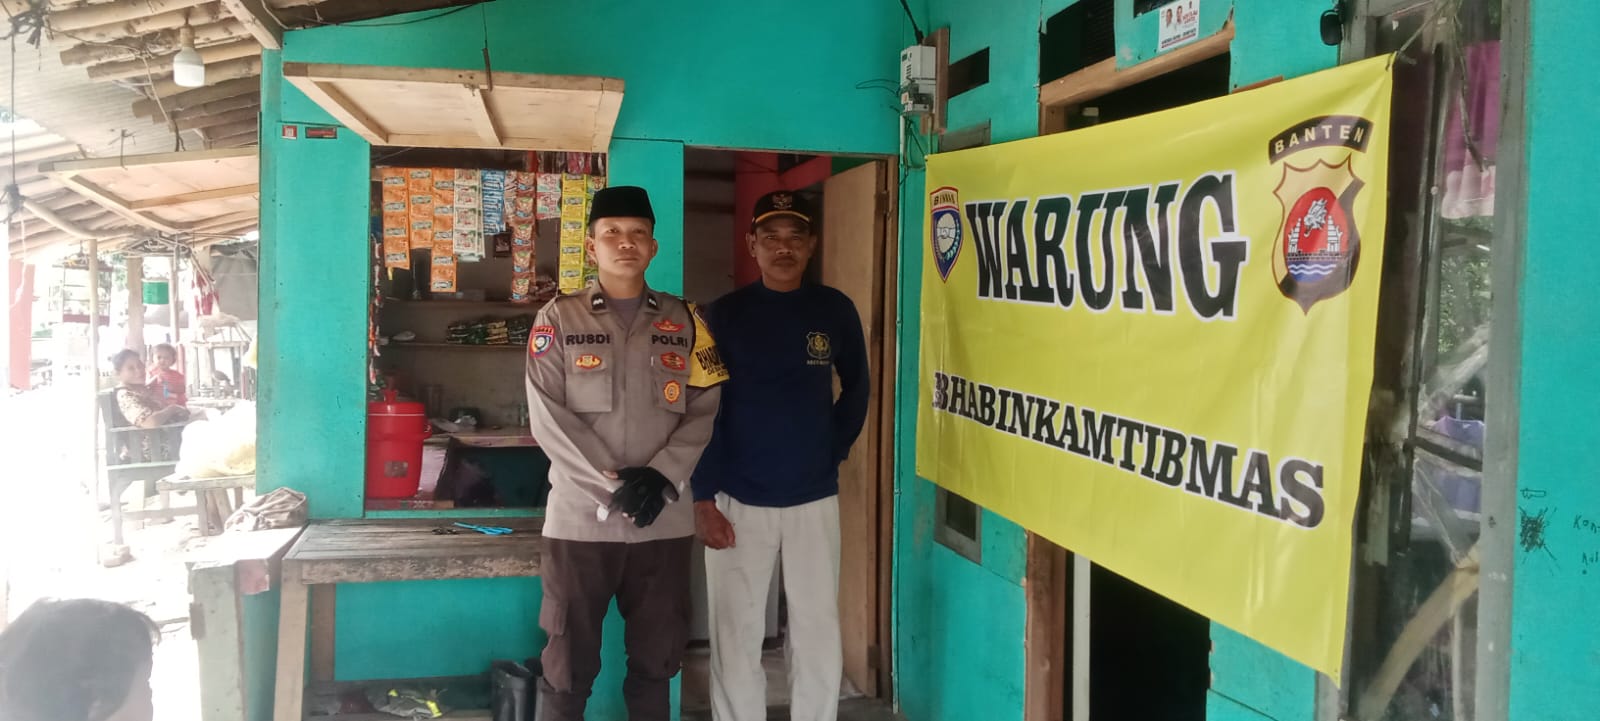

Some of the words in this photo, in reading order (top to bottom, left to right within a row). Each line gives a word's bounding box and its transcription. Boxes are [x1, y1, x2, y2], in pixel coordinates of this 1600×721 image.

[1273, 122, 1366, 156] BANTEN
[964, 173, 1248, 319] WARUNG
[565, 333, 611, 346] RUSDI
[651, 334, 688, 348] POLRI
[932, 370, 1325, 528] BHABINKAMTIBMAS
